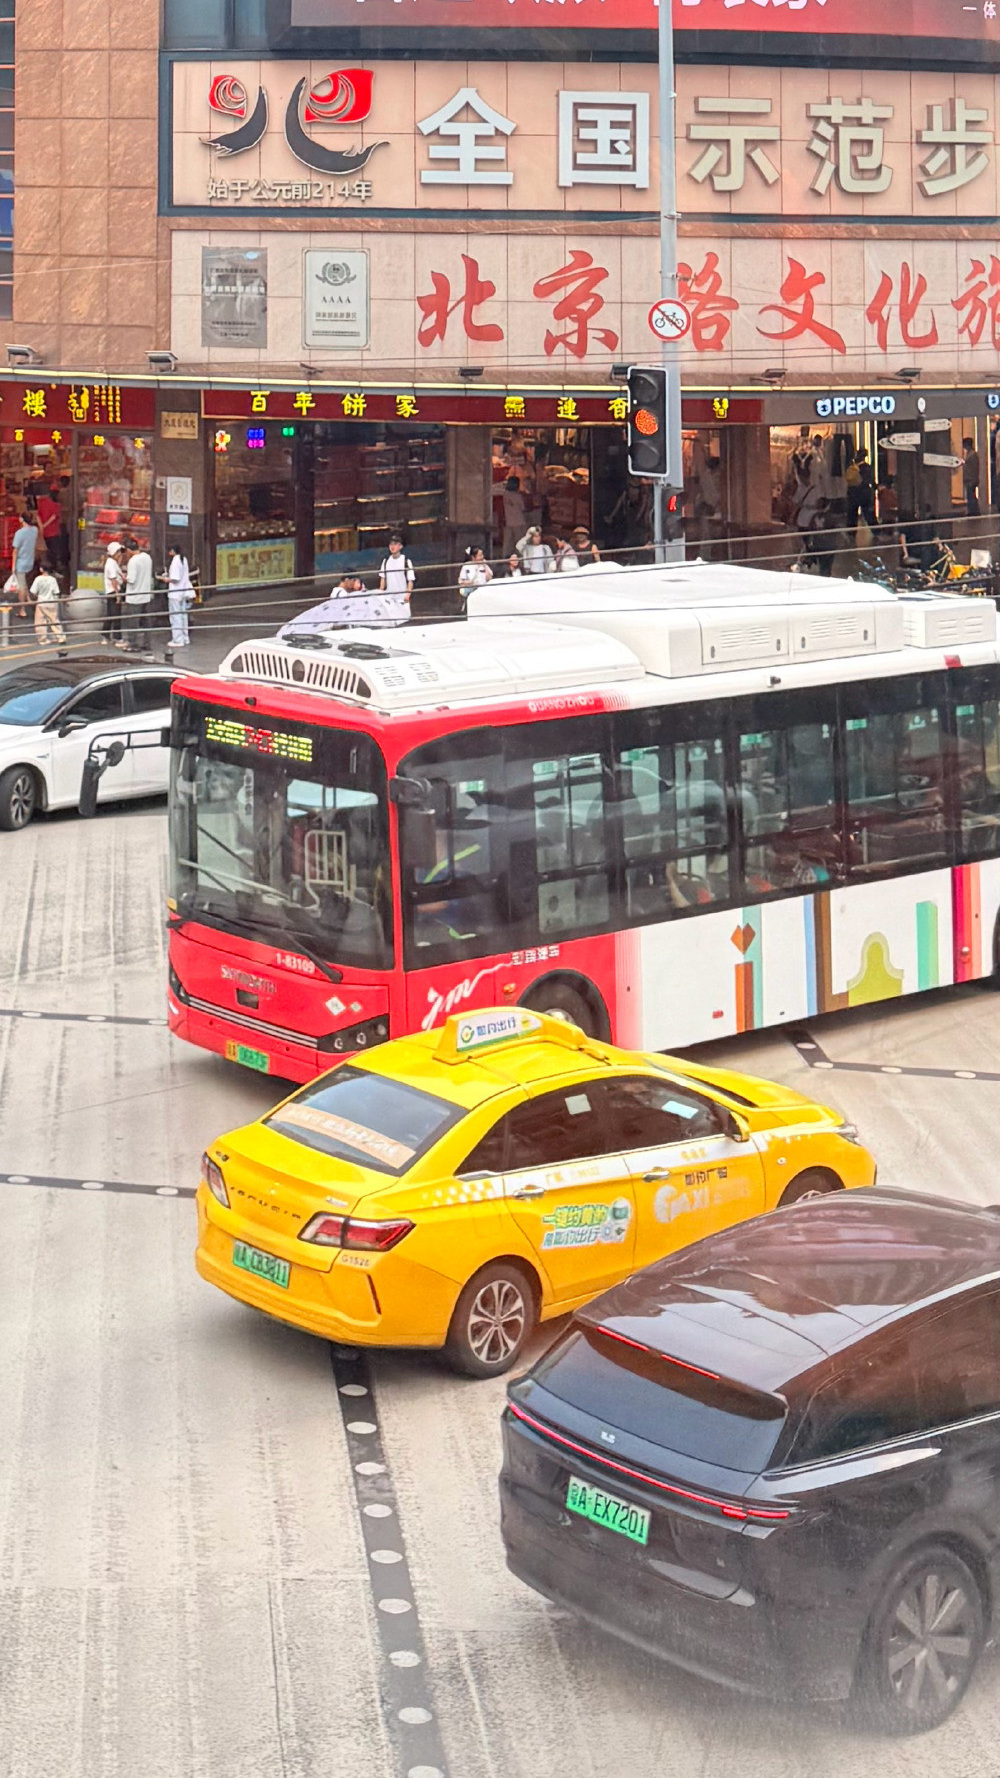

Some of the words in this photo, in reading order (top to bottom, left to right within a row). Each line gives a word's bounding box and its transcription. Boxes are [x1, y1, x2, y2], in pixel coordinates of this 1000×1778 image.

[417, 87, 994, 198] 全国示范步
[207, 179, 373, 201] 始于公元前214年
[833, 396, 895, 415] PEPCO
